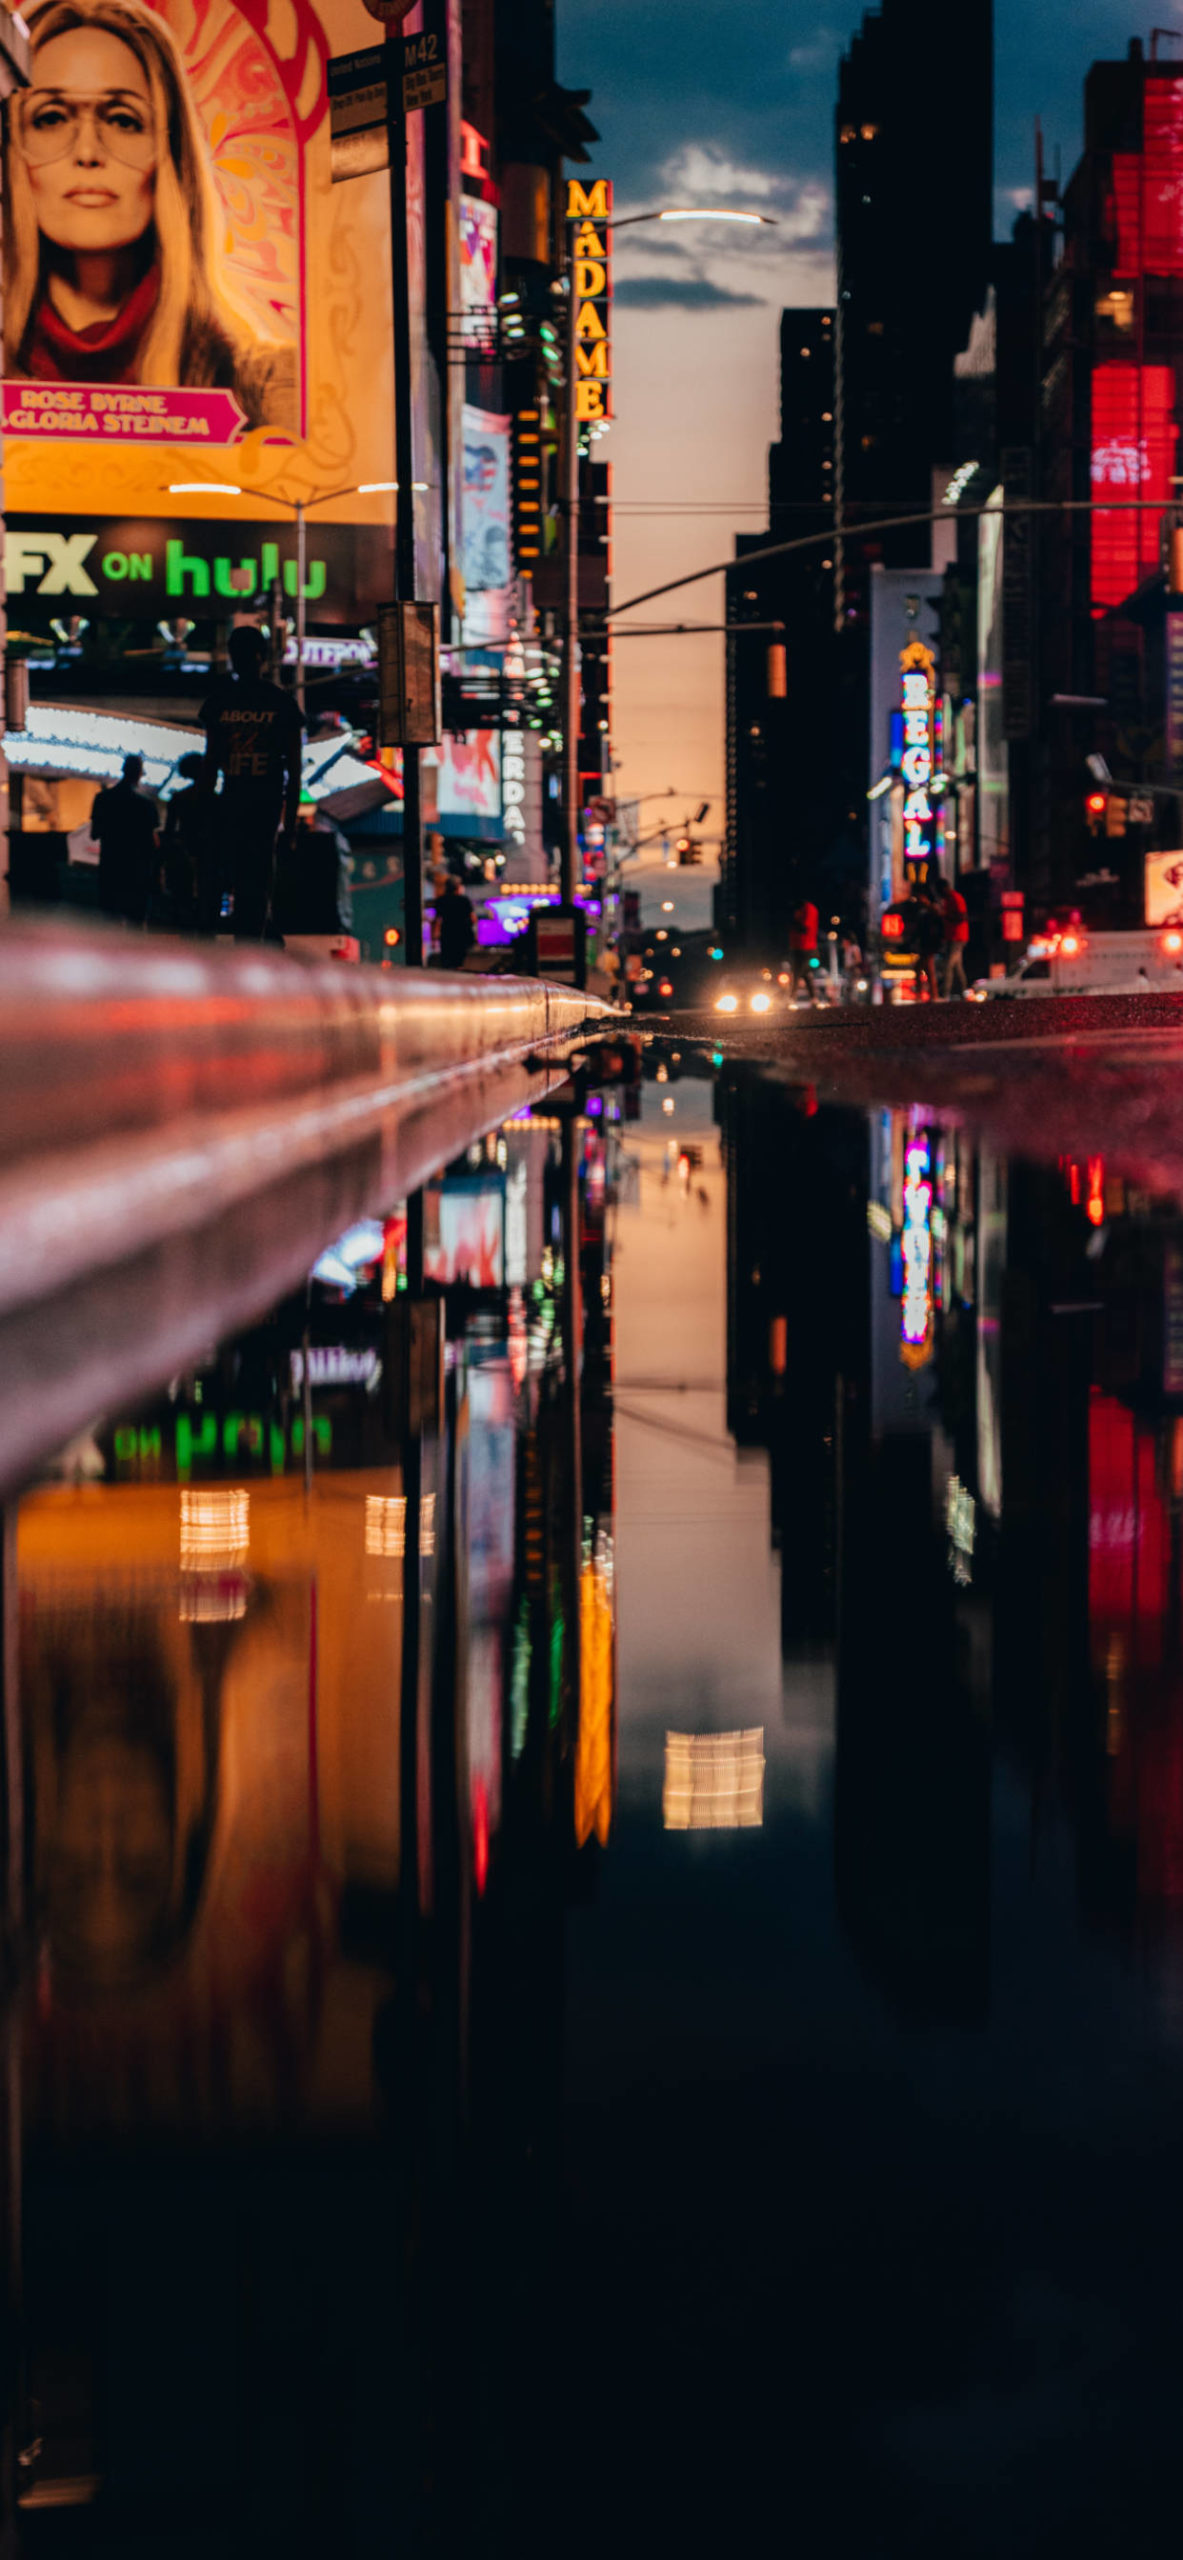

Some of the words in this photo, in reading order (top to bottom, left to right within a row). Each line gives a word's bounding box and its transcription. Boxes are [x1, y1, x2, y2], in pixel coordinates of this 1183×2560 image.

[404, 33, 438, 68] M42
[566, 178, 610, 420] MADAME
[20, 390, 87, 410] ROSE
[90, 393, 169, 414] BYRNE
[8, 410, 99, 432] GLORIA
[102, 414, 210, 436] STEINEM
[5, 532, 99, 596] FX
[102, 551, 153, 581] ON
[166, 539, 326, 599] hulu
[218, 709, 277, 724] ABOUT
[901, 674, 933, 857] REGAL
